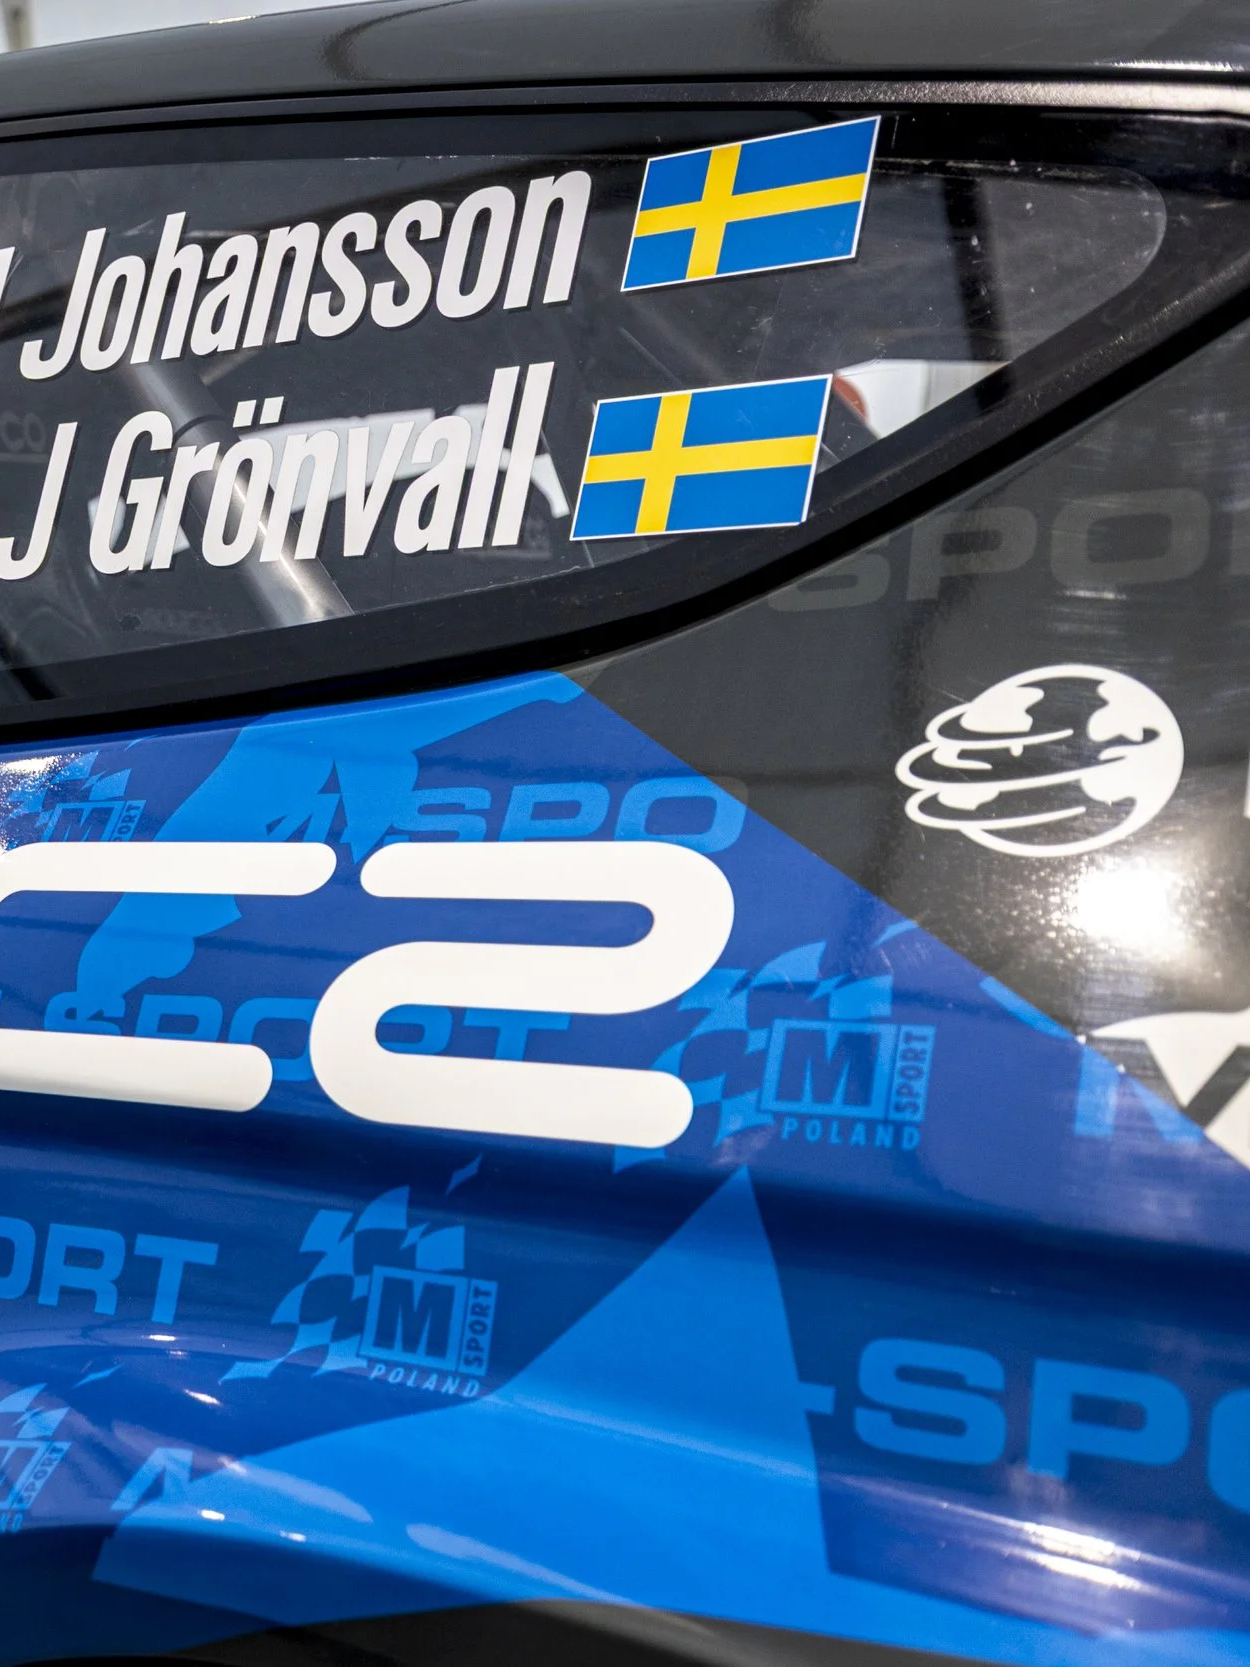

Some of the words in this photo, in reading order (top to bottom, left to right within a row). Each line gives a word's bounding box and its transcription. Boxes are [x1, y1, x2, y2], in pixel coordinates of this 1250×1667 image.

[19, 170, 592, 380] Johansson
[89, 361, 555, 576] Grönvall
[781, 1117, 921, 1150] POLAND
[368, 1363, 481, 1398] POLAND
